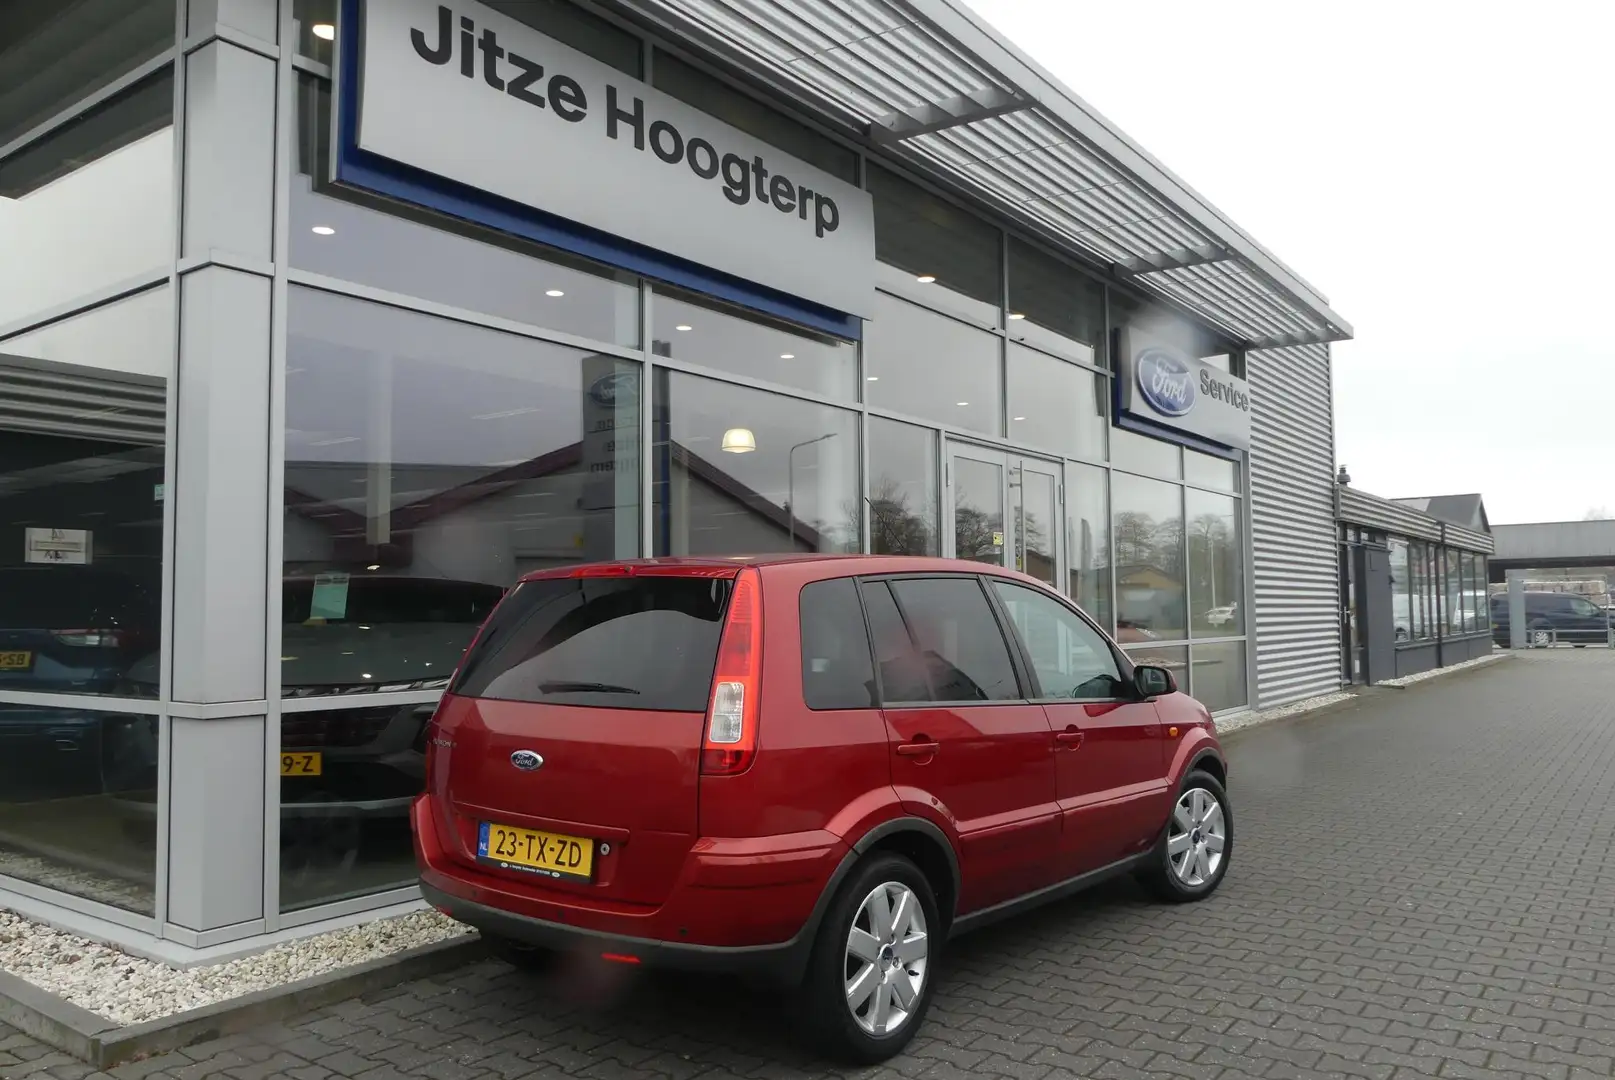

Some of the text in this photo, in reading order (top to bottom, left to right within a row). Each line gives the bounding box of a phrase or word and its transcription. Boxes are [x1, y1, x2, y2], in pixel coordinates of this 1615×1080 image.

[410, 5, 839, 238] Jitze Hoogterp
[1152, 358, 1249, 412] Ford Service
[479, 829, 582, 868] NL 23-TX-ZD
